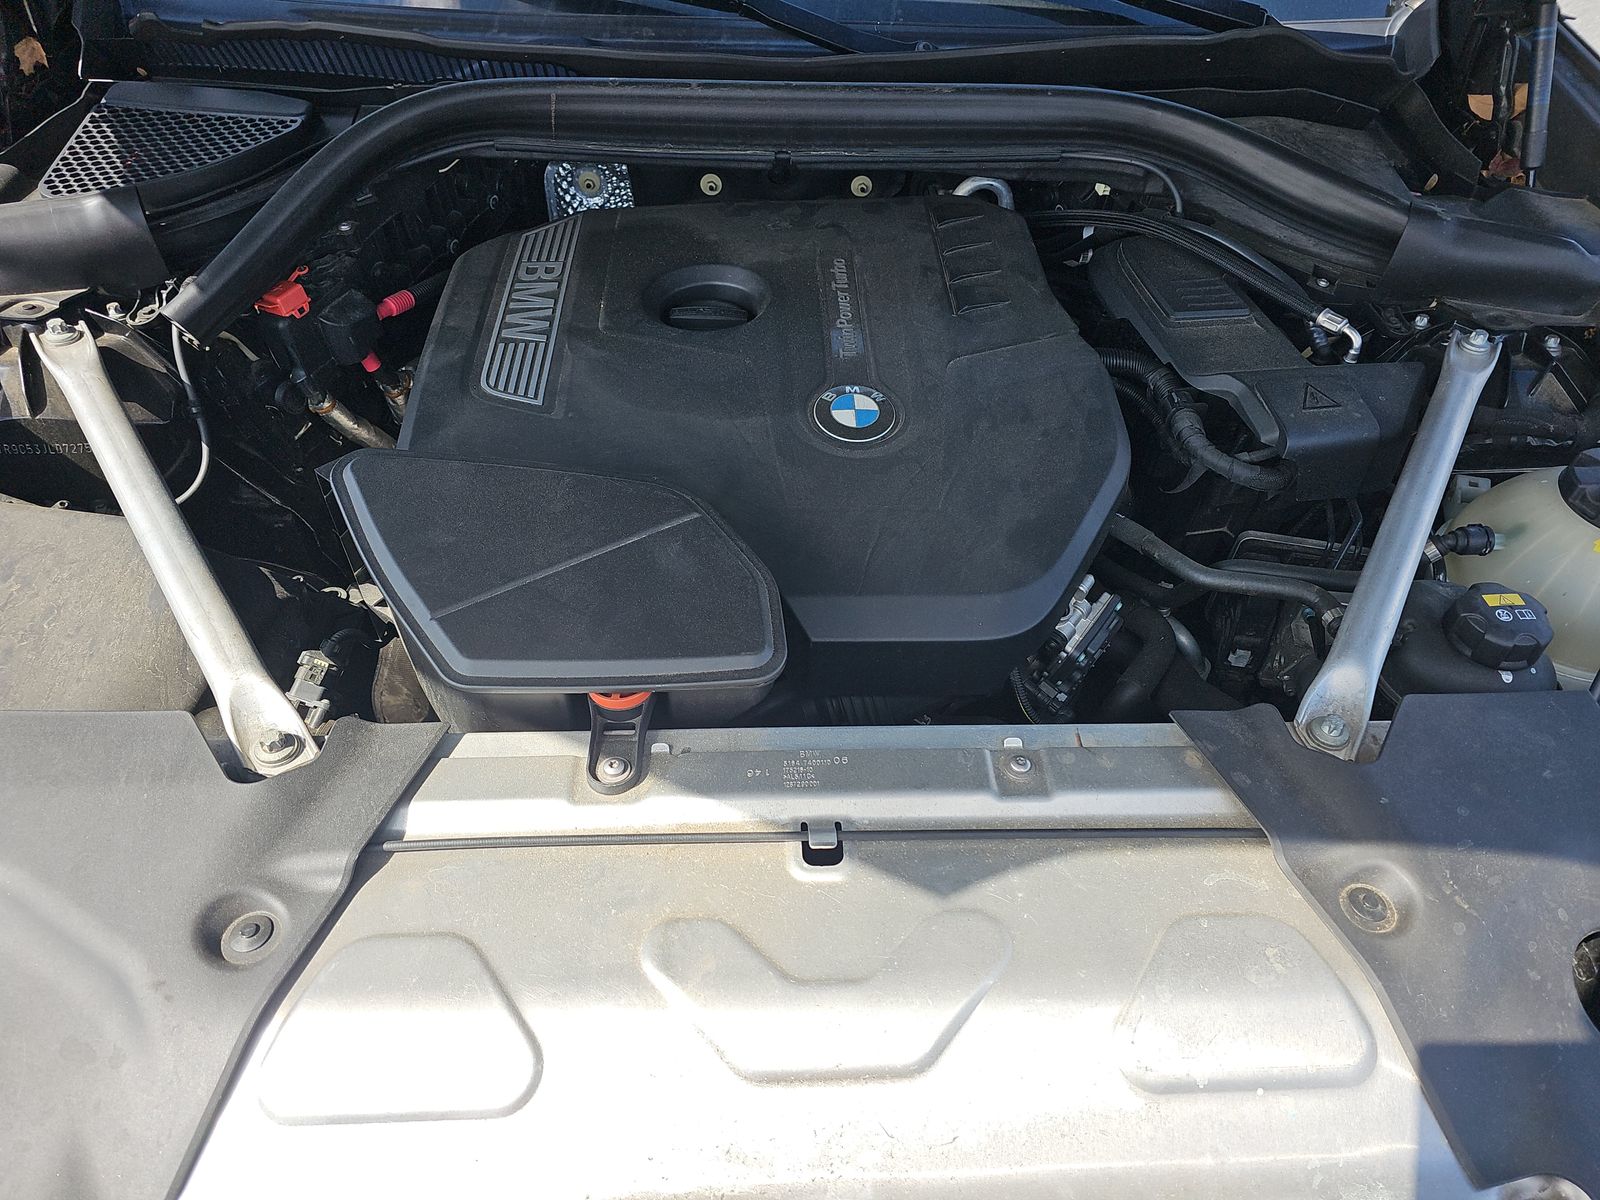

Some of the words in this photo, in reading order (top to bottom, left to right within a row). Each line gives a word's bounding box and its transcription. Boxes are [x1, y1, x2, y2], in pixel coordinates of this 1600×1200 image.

[501, 261, 564, 342] BMW
[821, 386, 887, 403] BMW
[0, 442, 92, 455] R9C53JLD7275
